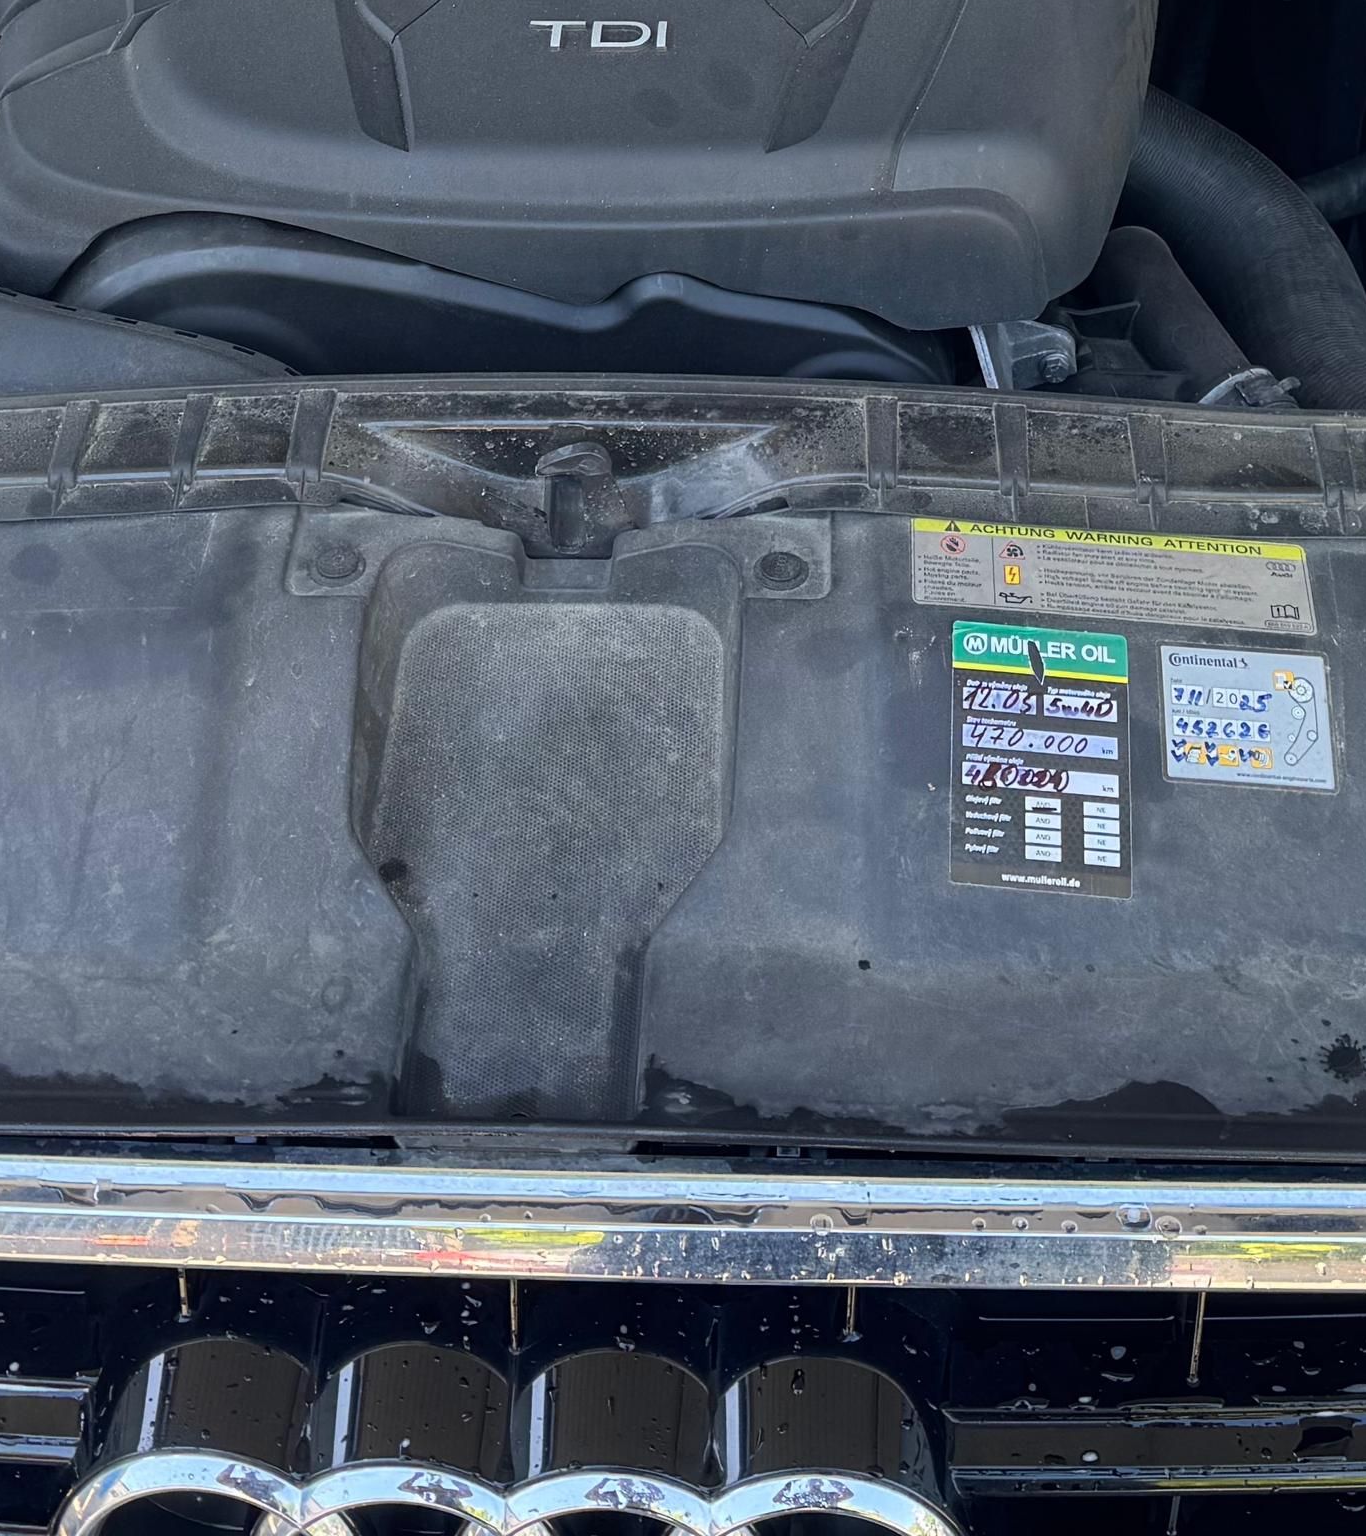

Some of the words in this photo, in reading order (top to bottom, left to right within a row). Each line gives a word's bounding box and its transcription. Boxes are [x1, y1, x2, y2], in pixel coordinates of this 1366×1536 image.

[530, 19, 668, 50] TDI
[970, 524, 1055, 538] ACHTUNG
[1065, 530, 1153, 546] WARNING
[1164, 539, 1262, 555] ATTENTION
[1081, 644, 1116, 664] OIL
[1168, 652, 1238, 669] Continental
[971, 720, 1088, 753] 470.000
[1102, 747, 1114, 755] km
[1102, 785, 1115, 793] km
